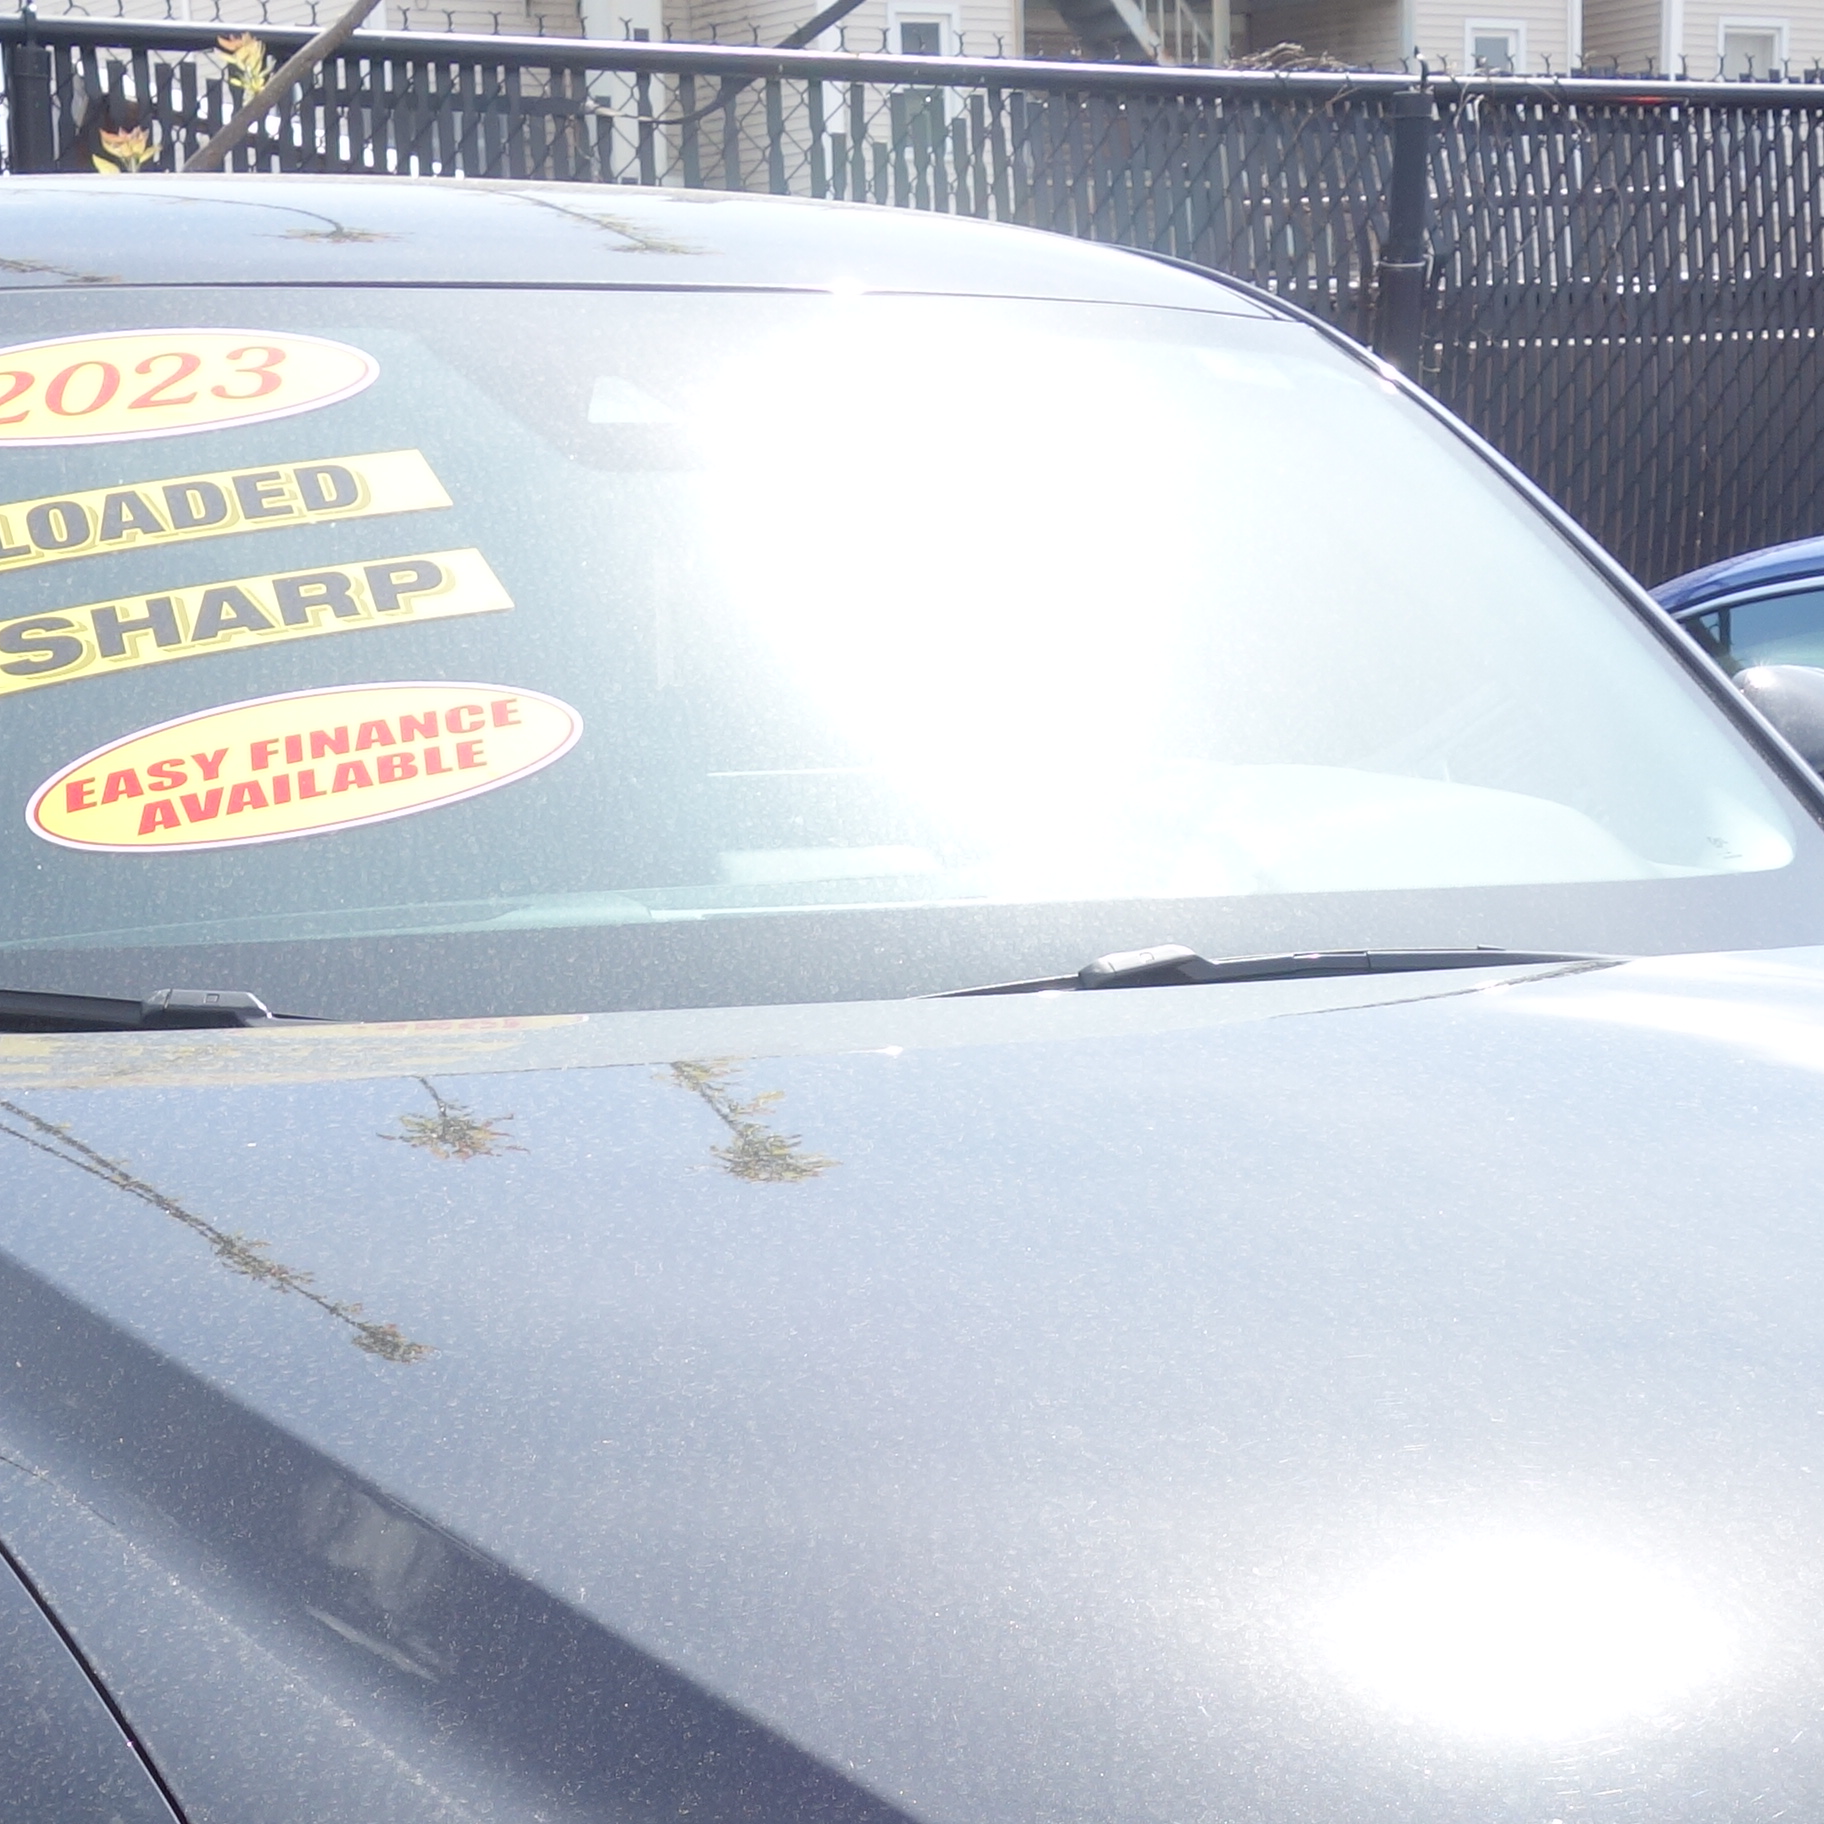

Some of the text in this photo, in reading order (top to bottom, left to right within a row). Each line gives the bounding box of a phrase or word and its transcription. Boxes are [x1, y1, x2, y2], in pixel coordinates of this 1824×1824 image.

[64, 697, 523, 814] EASY FINANCE
[137, 738, 489, 837] AVAILABLE
